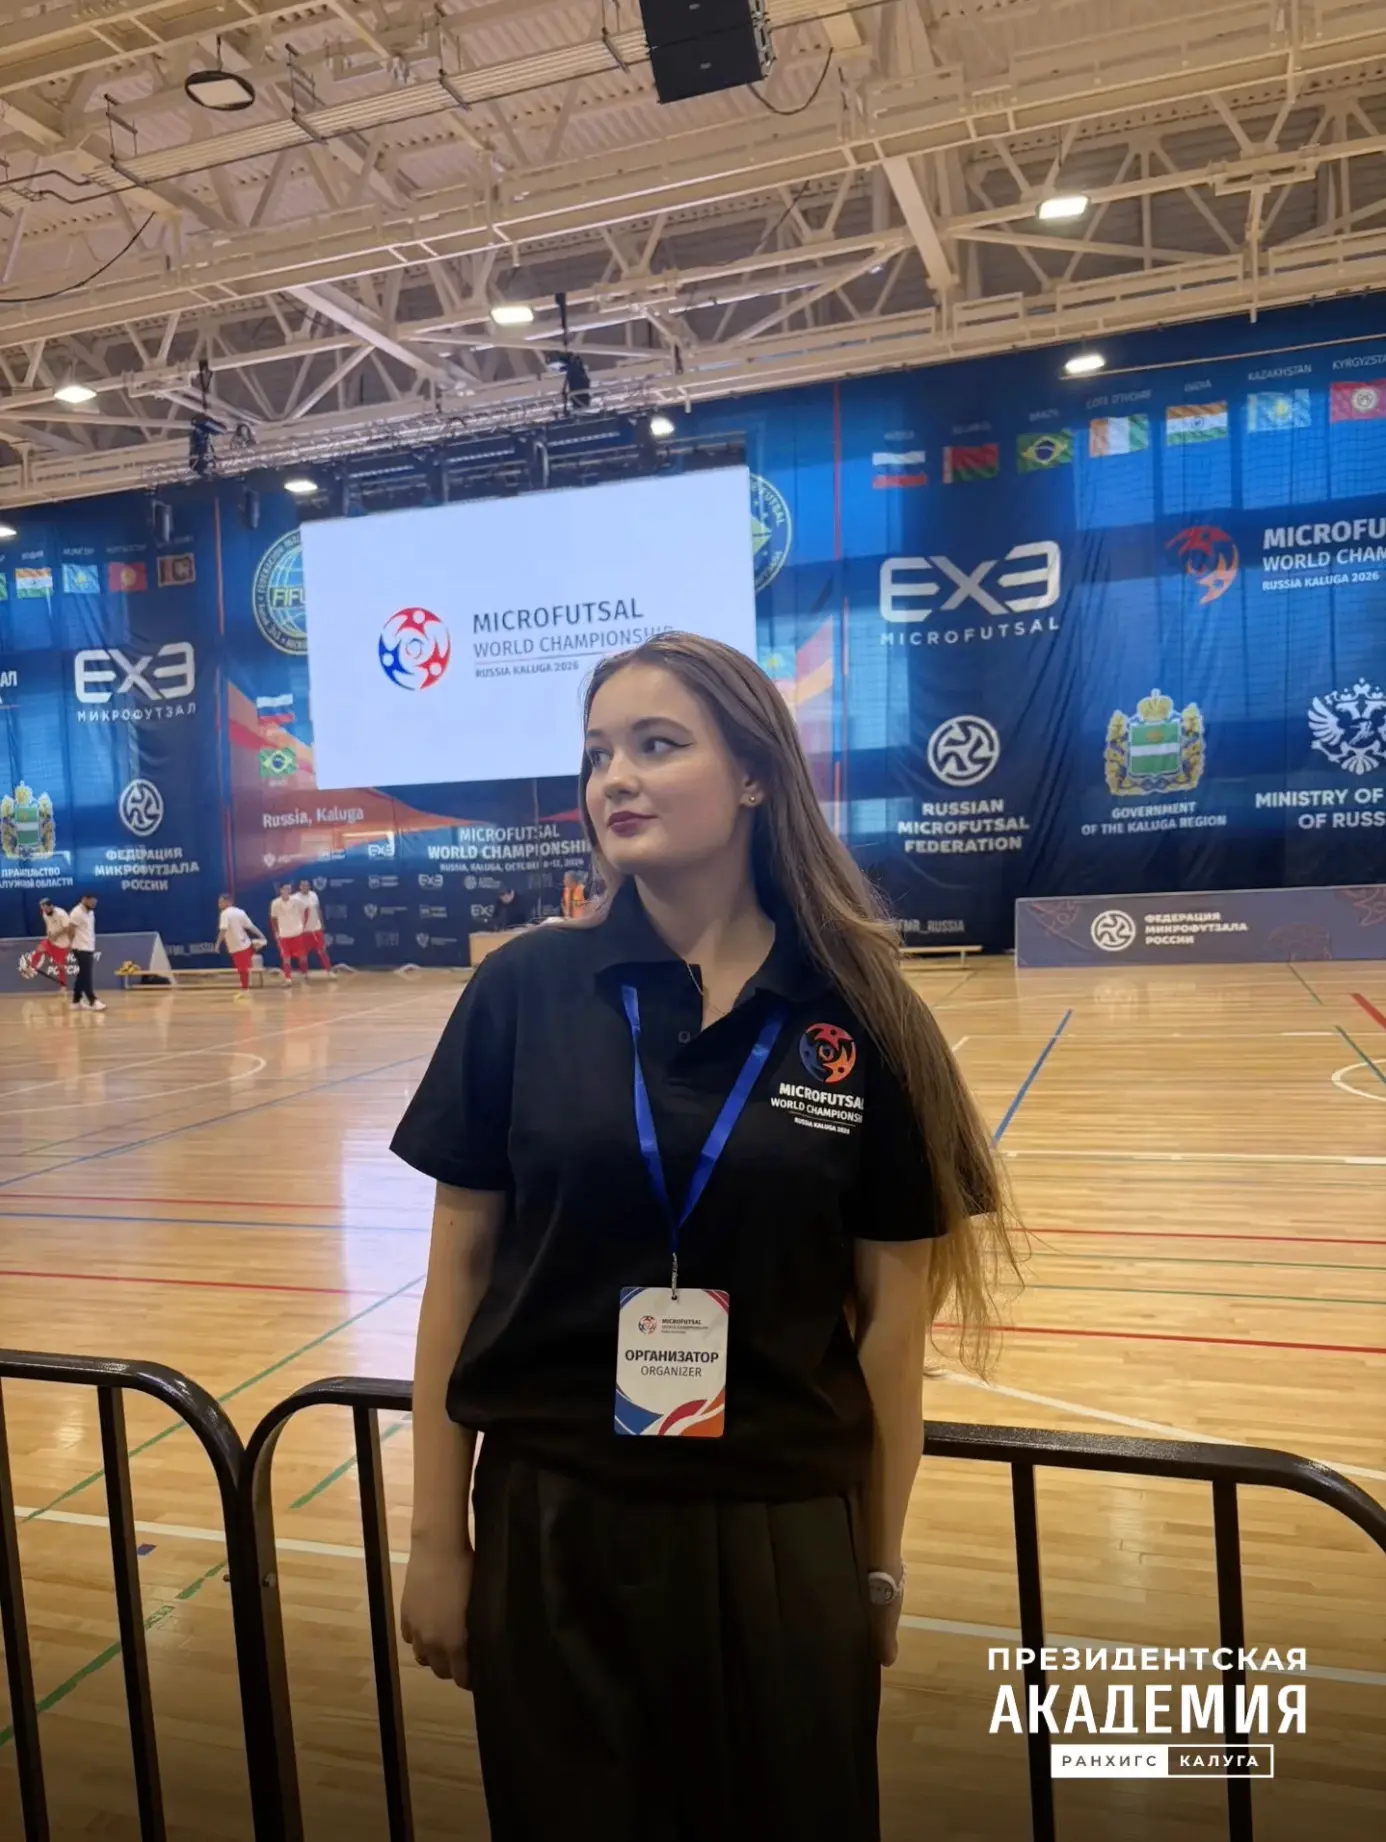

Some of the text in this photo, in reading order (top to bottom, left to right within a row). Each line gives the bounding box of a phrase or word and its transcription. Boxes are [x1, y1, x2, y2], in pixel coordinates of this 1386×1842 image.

[1248, 364, 1312, 382] KAZAKHSTAN
[1263, 552, 1330, 572] WORLD
[1262, 571, 1379, 591] RUSSIA KALUGA 2026
[473, 598, 644, 634] MICROFUTSAL
[880, 617, 1059, 645] MICROFUTSAL
[473, 638, 534, 658] WORLD
[476, 660, 579, 678] RUSSIA KALUGA 2026
[78, 703, 196, 722] МИКРОФУТЗАЛ
[1255, 788, 1384, 808] MINISTRY OF
[922, 799, 1004, 816] RUSSIAN
[1112, 801, 1196, 819] GOVERNMENT
[263, 806, 363, 828] Russia, Kaluga
[897, 816, 1030, 835] MICROFUTSAL
[1081, 815, 1227, 836] OF THE KALUGA REGION
[1298, 813, 1327, 829] OF
[428, 844, 477, 860] WORLD
[904, 836, 1023, 853] FEDERATION
[106, 847, 182, 861] ФЕДЕРАЦИЯ
[95, 862, 199, 876] МИКРОФУТЗАЛА
[122, 879, 168, 891] РОССИИ
[1144, 912, 1221, 923] ФЕДЕРАЦИЯ
[1145, 923, 1248, 934] МИКРОФУТЗАЛА
[1145, 935, 1194, 945] РОССИИ
[770, 1097, 805, 1111] WORLD
[625, 1349, 719, 1363] ОРГАНИЗАТОР
[641, 1366, 702, 1377] ORGANIZER
